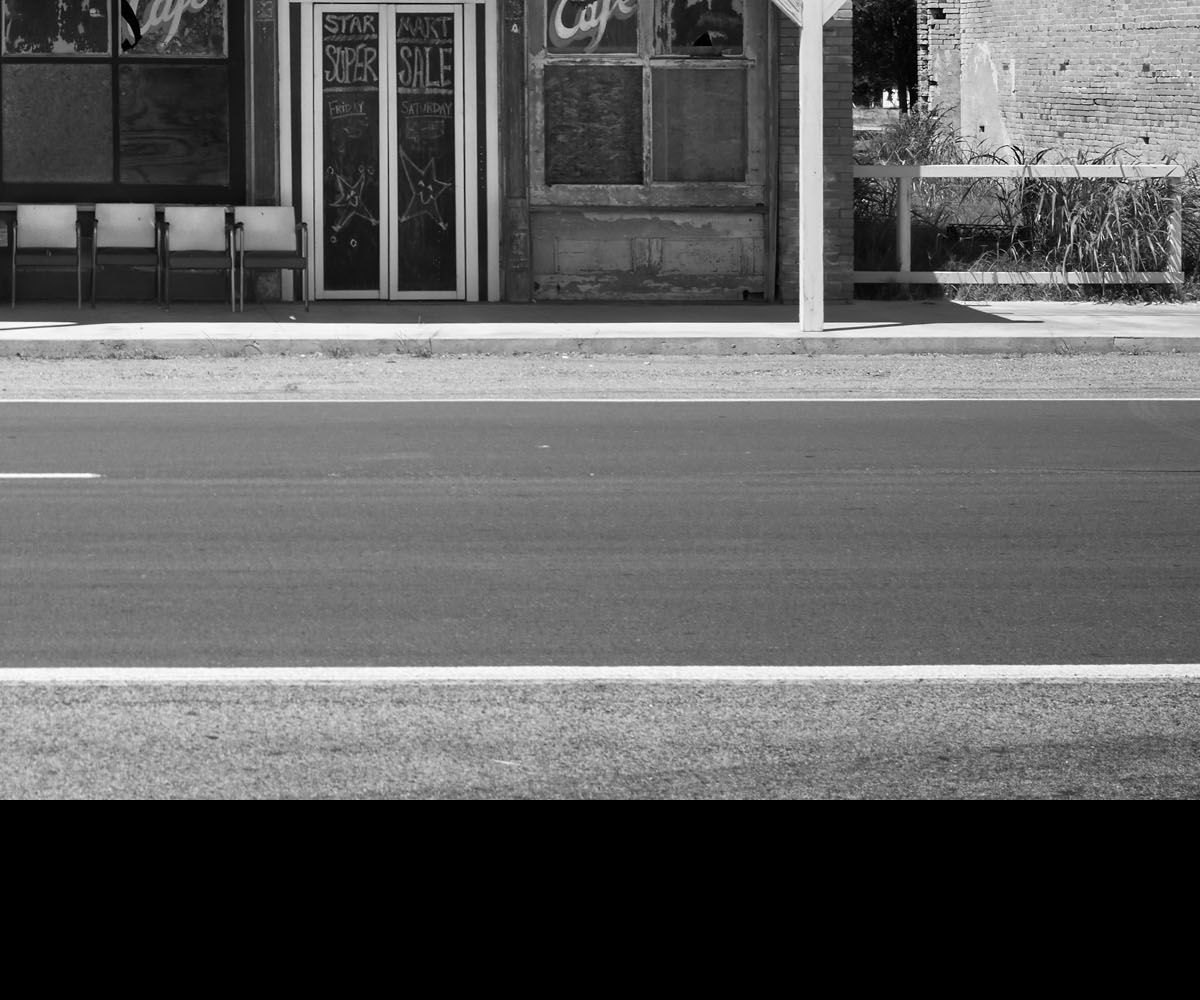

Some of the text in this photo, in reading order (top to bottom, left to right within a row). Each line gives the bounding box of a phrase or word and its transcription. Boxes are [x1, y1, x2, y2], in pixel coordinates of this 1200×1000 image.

[323, 13, 453, 39] STAR MART
[324, 43, 453, 88] SUPER SALE
[401, 100, 453, 116] SATURDAY
